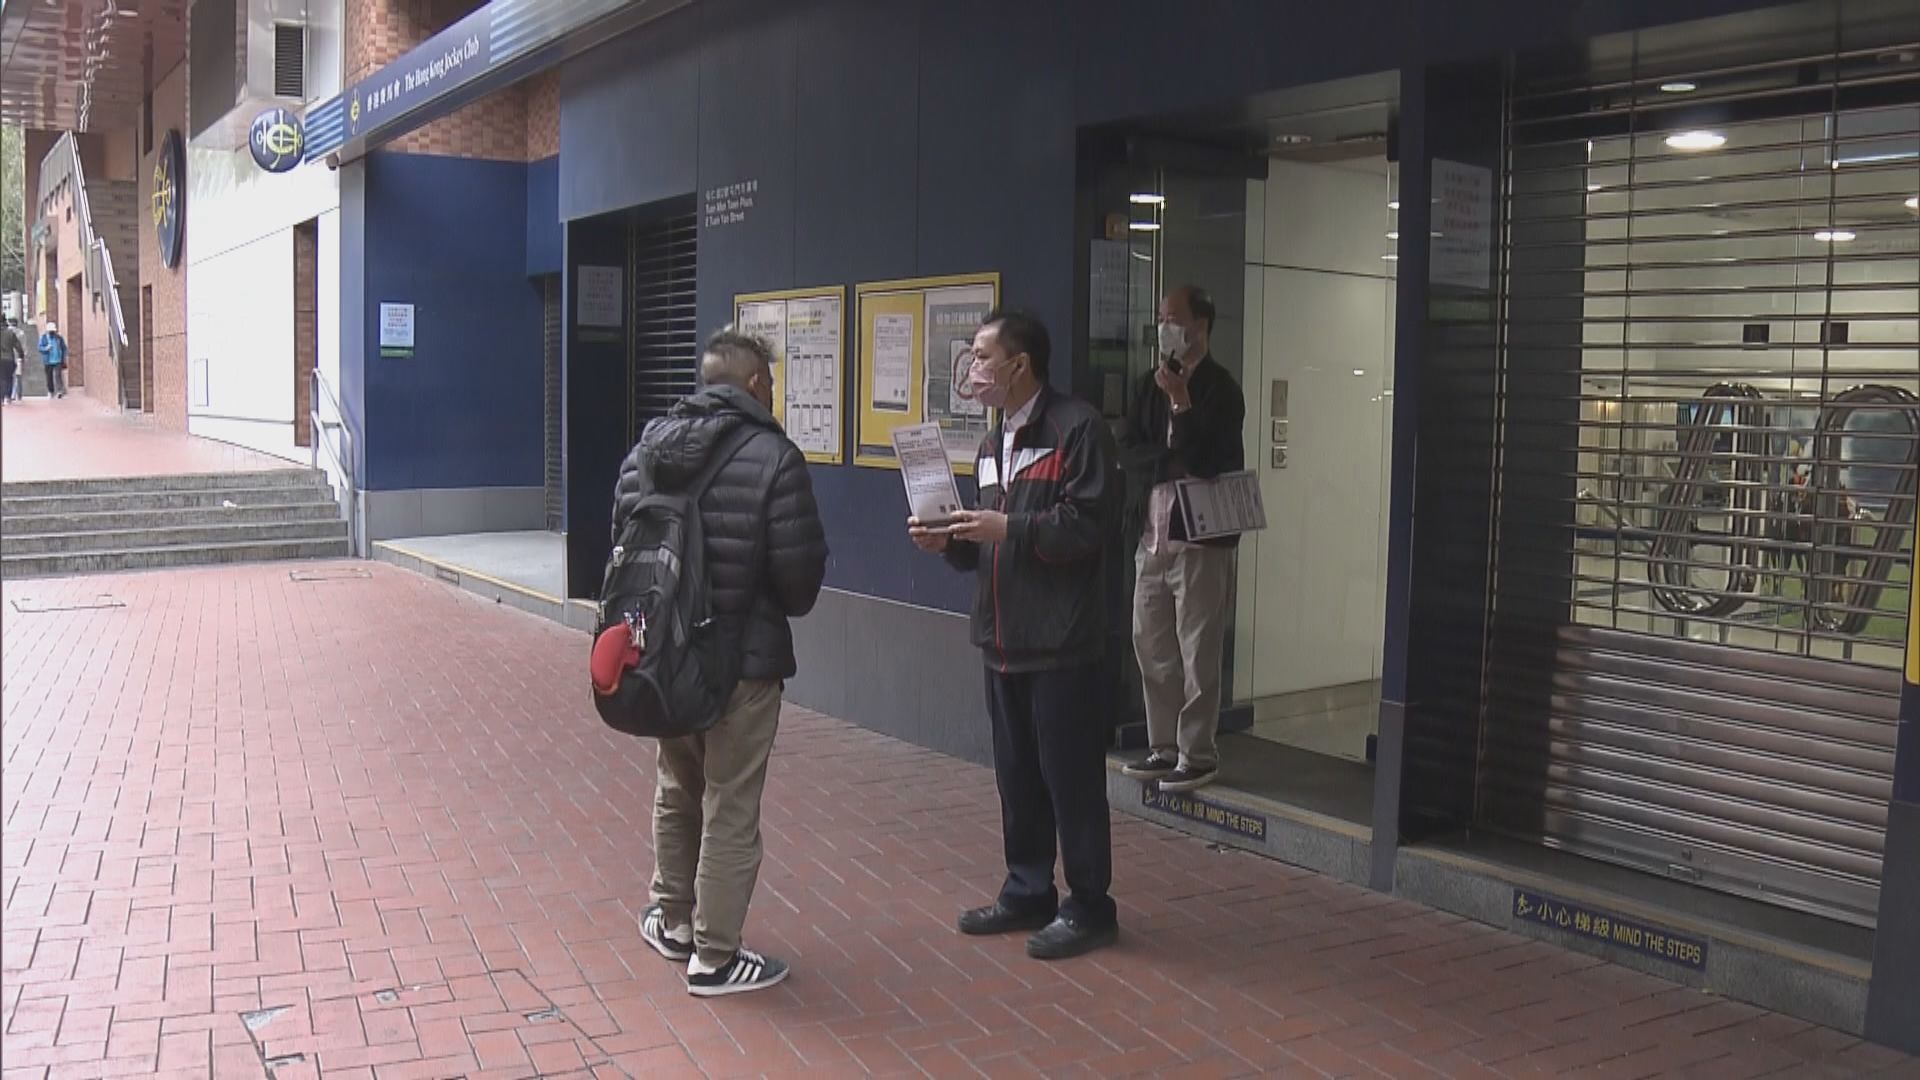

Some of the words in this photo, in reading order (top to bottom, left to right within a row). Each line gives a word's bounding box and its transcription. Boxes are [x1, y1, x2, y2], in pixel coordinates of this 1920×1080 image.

[405, 71, 414, 92] The
[415, 66, 429, 87] Hong
[429, 59, 443, 79] Kong
[443, 47, 463, 75] Jockey
[464, 34, 479, 60] Club
[1206, 806, 1225, 825] MIND
[1226, 812, 1240, 829] THE
[1240, 816, 1263, 835] STEPS
[1537, 901, 1610, 938] 小心梯級
[1613, 923, 1642, 947] MIND
[1645, 932, 1664, 953] THE
[1667, 938, 1701, 964] STEPS
